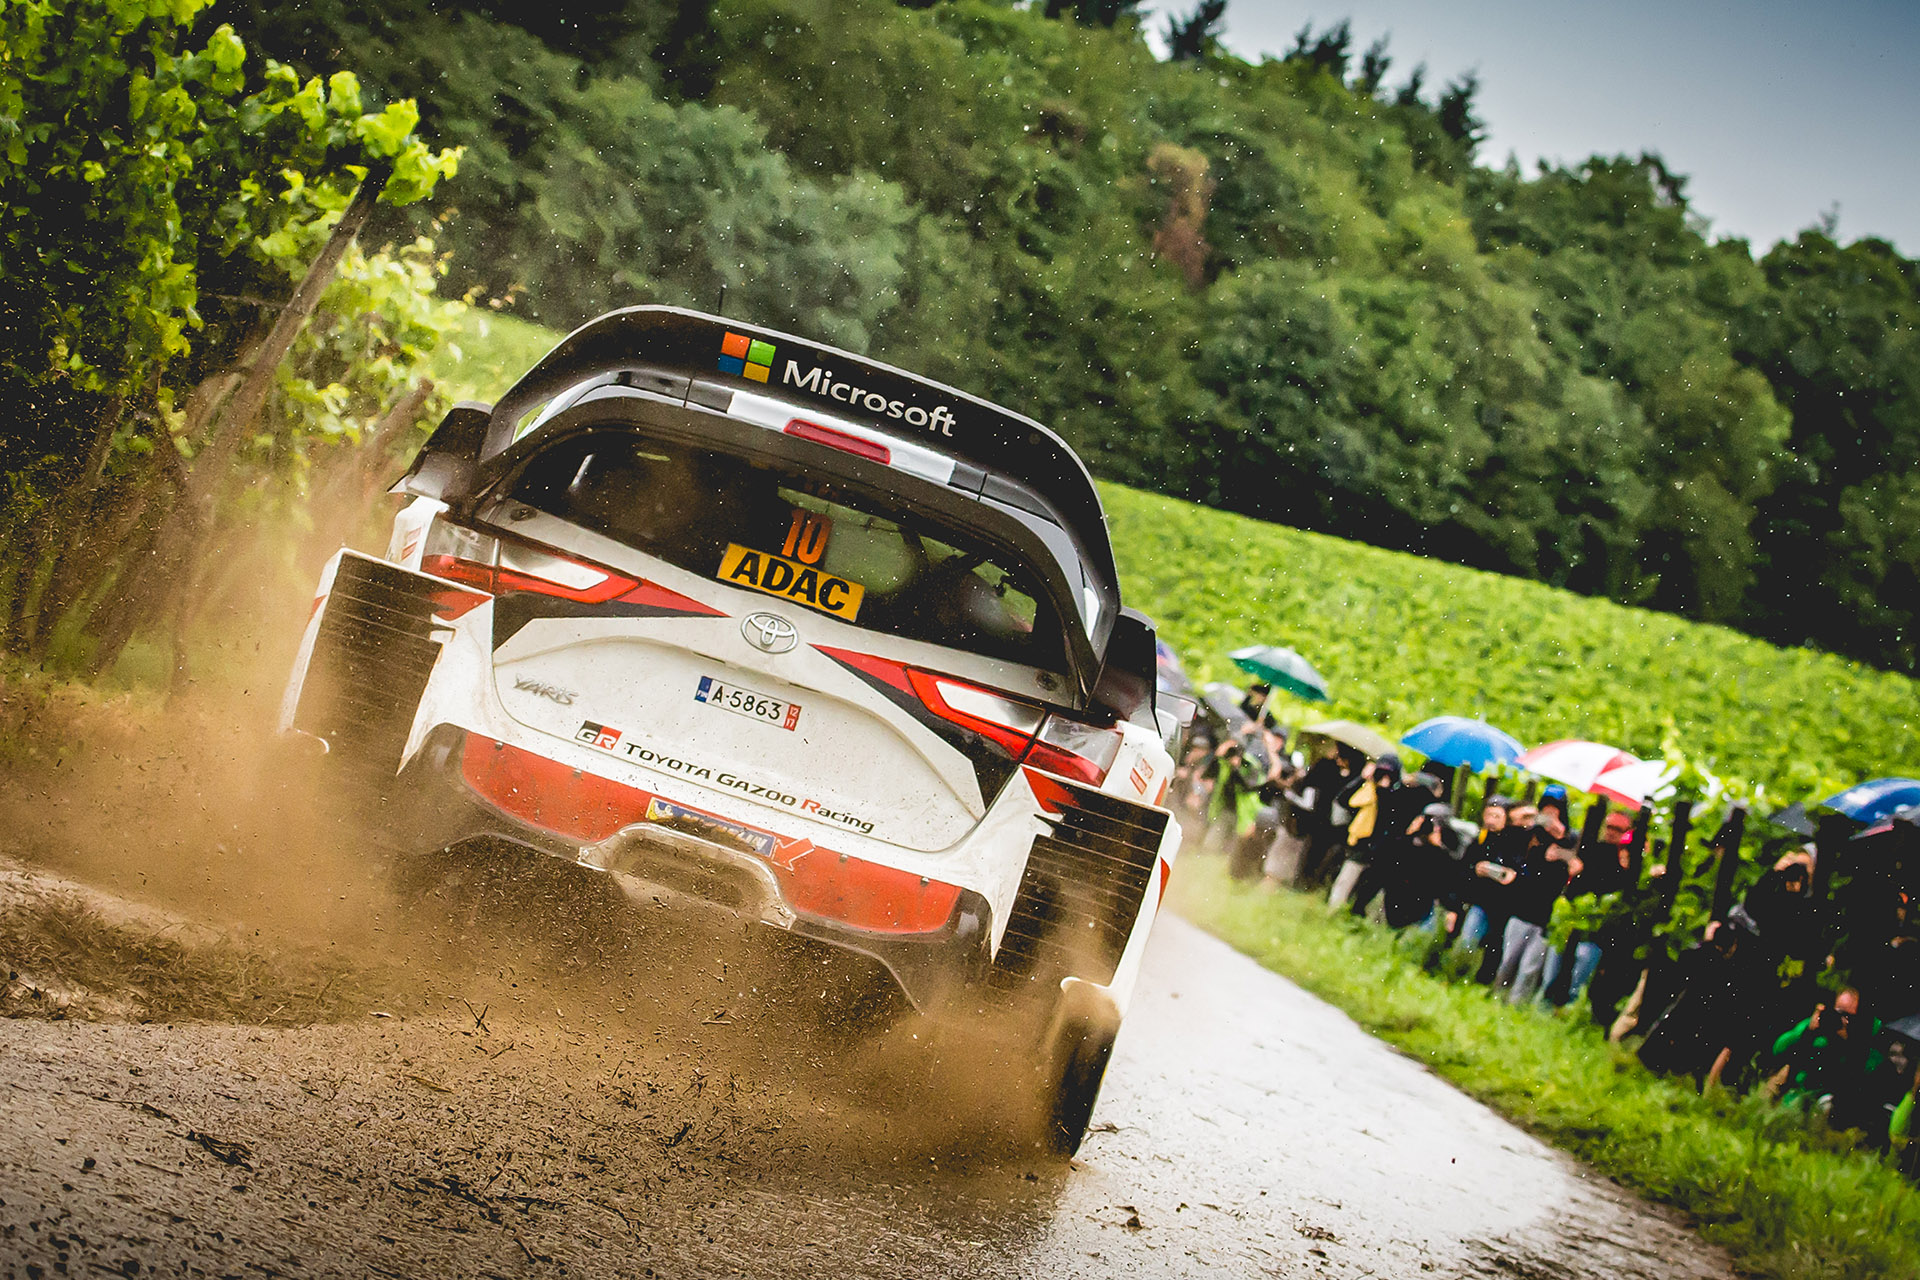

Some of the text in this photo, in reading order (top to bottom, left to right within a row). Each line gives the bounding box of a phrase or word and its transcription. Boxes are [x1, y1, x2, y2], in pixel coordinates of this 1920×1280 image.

[783, 359, 956, 437] Microsoft
[781, 508, 833, 565] 10
[730, 551, 850, 611] ADAC
[575, 727, 618, 750] GR
[626, 742, 711, 779] TOYOTA
[716, 773, 797, 807] GAZOO
[800, 798, 875, 834] Racing
